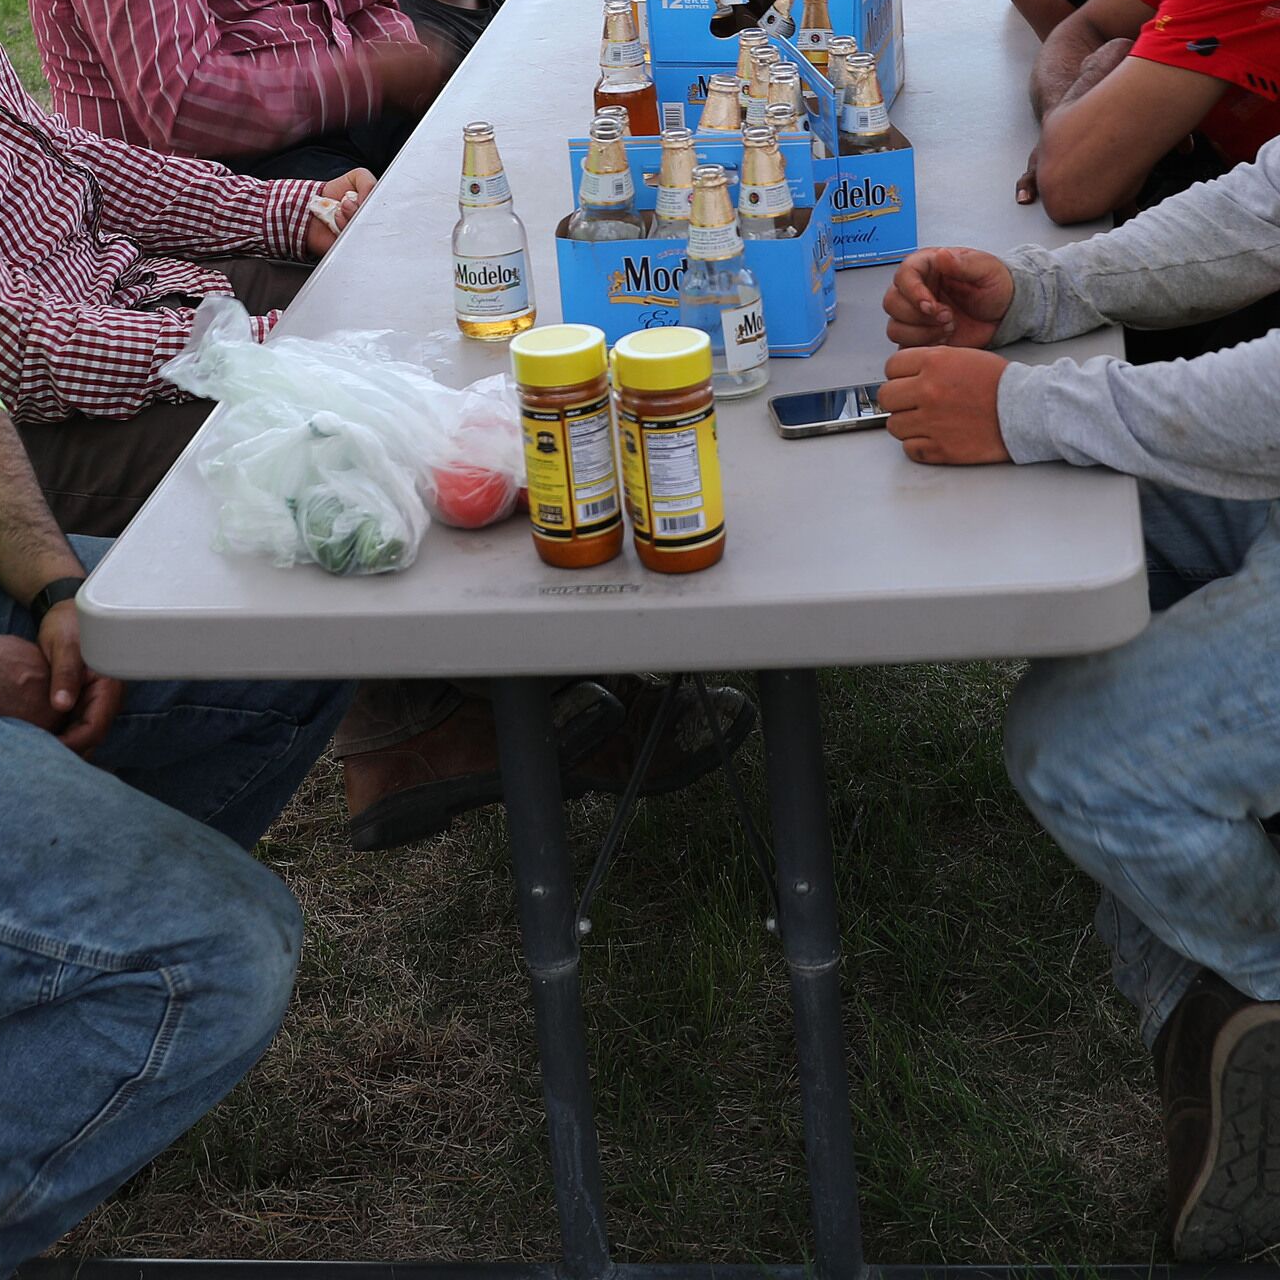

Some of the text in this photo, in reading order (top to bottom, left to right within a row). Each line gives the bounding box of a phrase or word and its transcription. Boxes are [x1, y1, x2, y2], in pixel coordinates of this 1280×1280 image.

[829, 177, 887, 210] delo
[457, 263, 512, 286] Modelo
[623, 255, 689, 294] Mod
